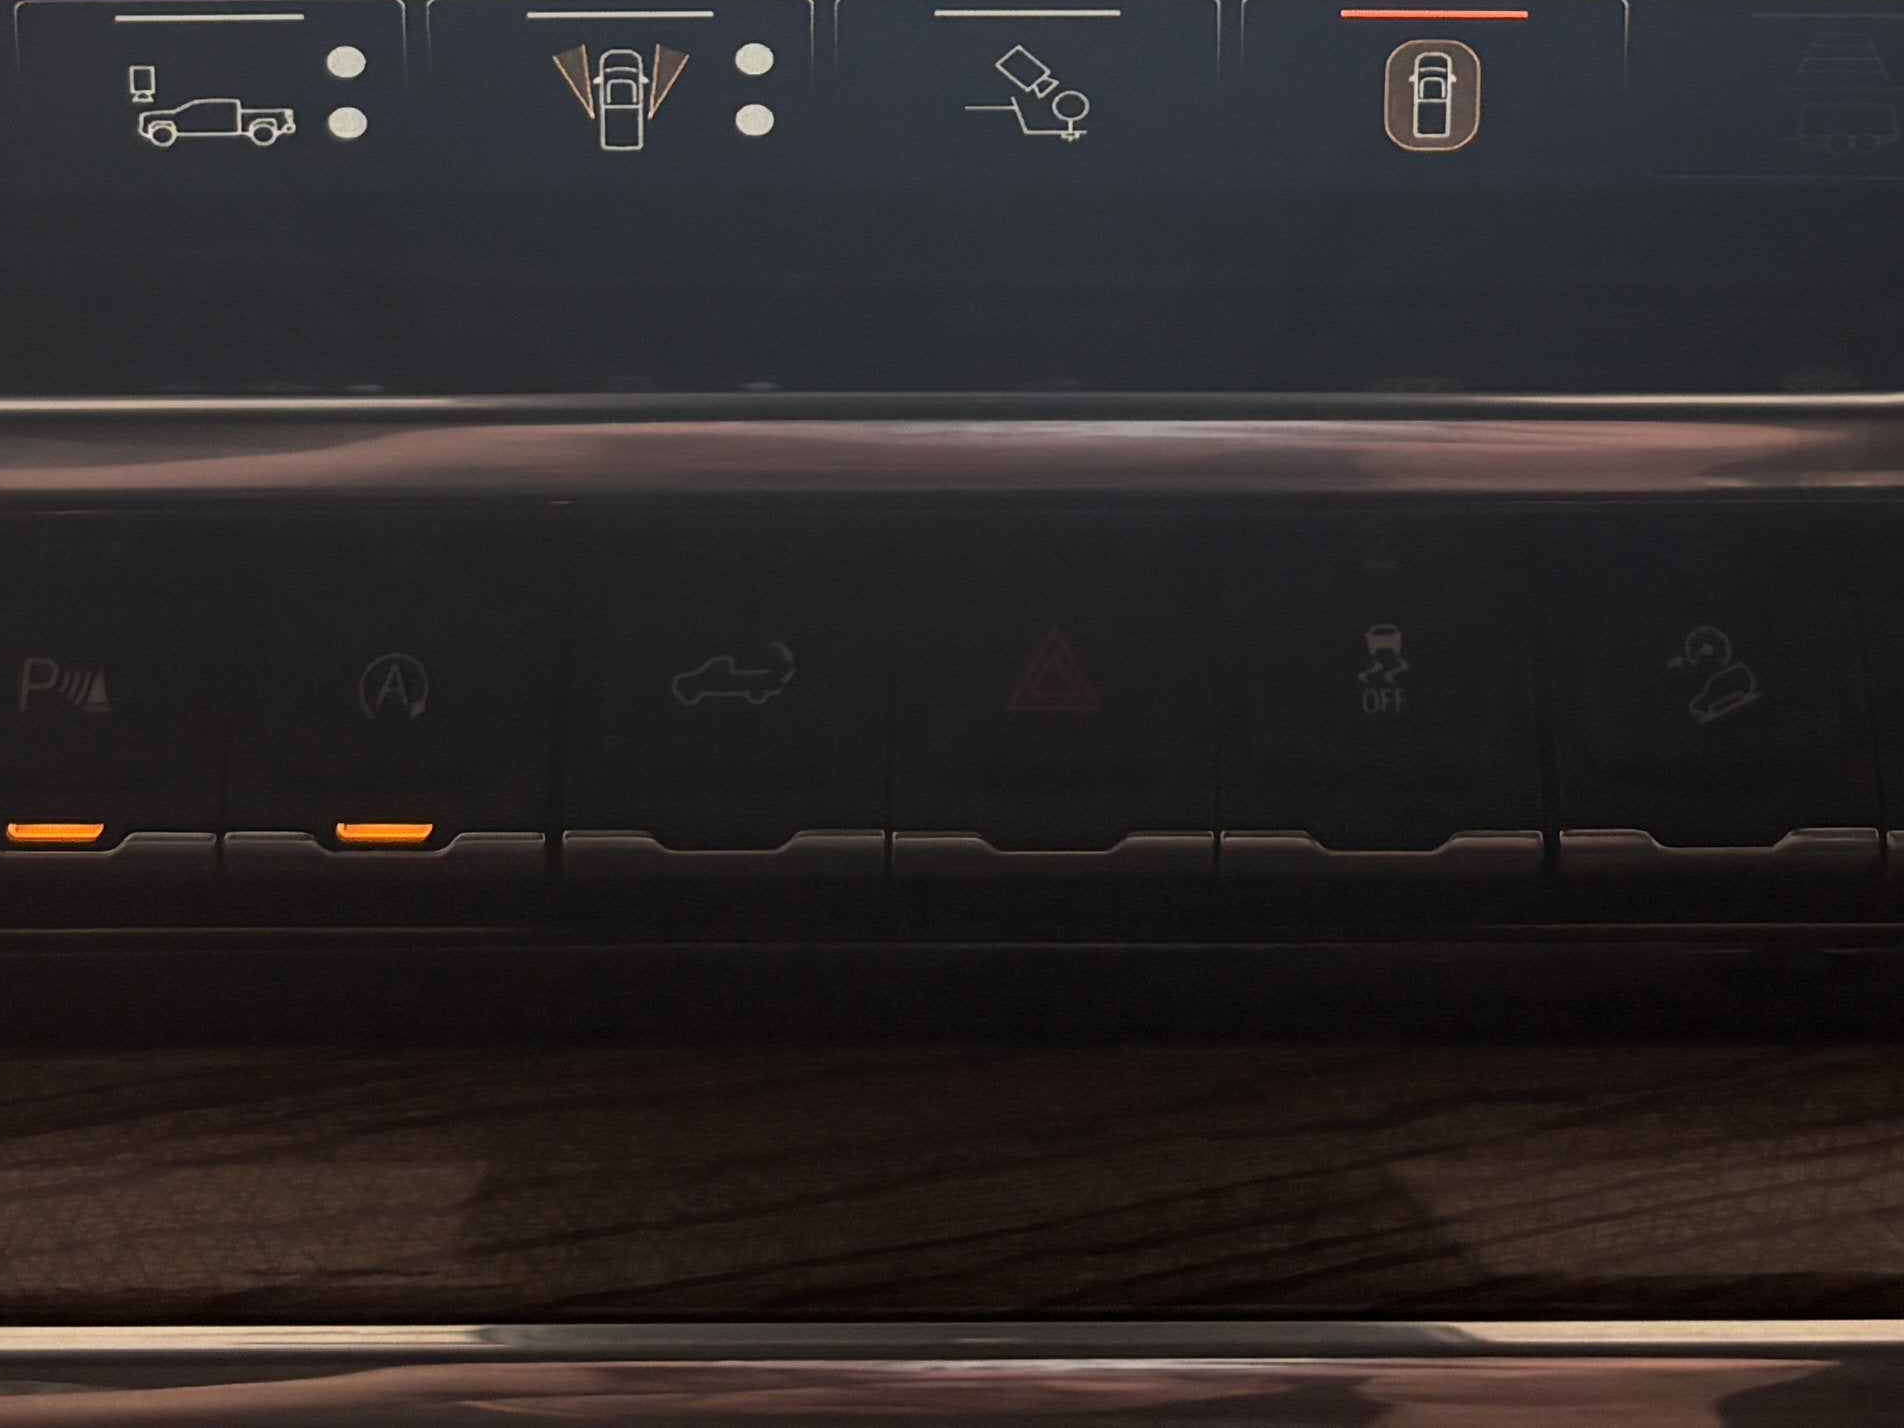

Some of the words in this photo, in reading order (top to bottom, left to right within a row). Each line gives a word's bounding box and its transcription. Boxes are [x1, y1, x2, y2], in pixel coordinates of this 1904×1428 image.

[19, 657, 60, 711] P
[378, 663, 409, 706] A
[1362, 688, 1406, 714] OFF
